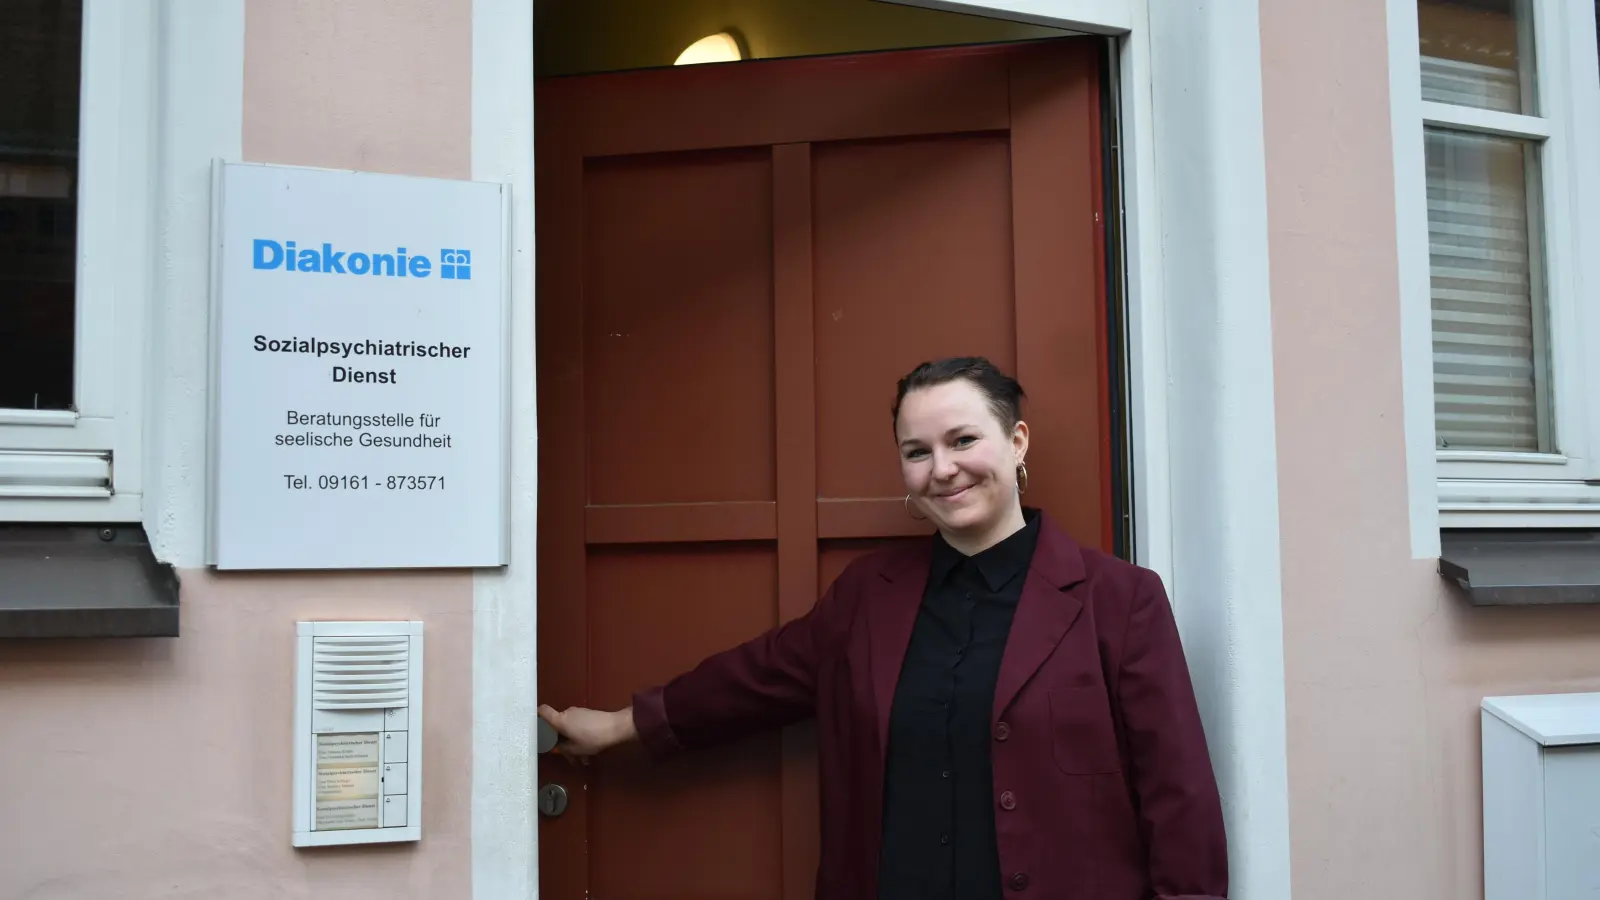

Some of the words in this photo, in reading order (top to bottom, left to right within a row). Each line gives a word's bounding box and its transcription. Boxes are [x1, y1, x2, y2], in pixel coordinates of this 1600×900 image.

[253, 239, 431, 278] Diakonie
[253, 335, 471, 358] Sozialpsychiatrischer
[332, 366, 397, 384] Dienst
[287, 411, 414, 429] Beratungsstelle
[419, 412, 441, 428] für
[275, 432, 353, 446] seelische
[359, 433, 452, 448] Gesundheit
[284, 475, 312, 489] Tel.
[318, 475, 369, 490] 09161
[387, 476, 446, 490] 873571
